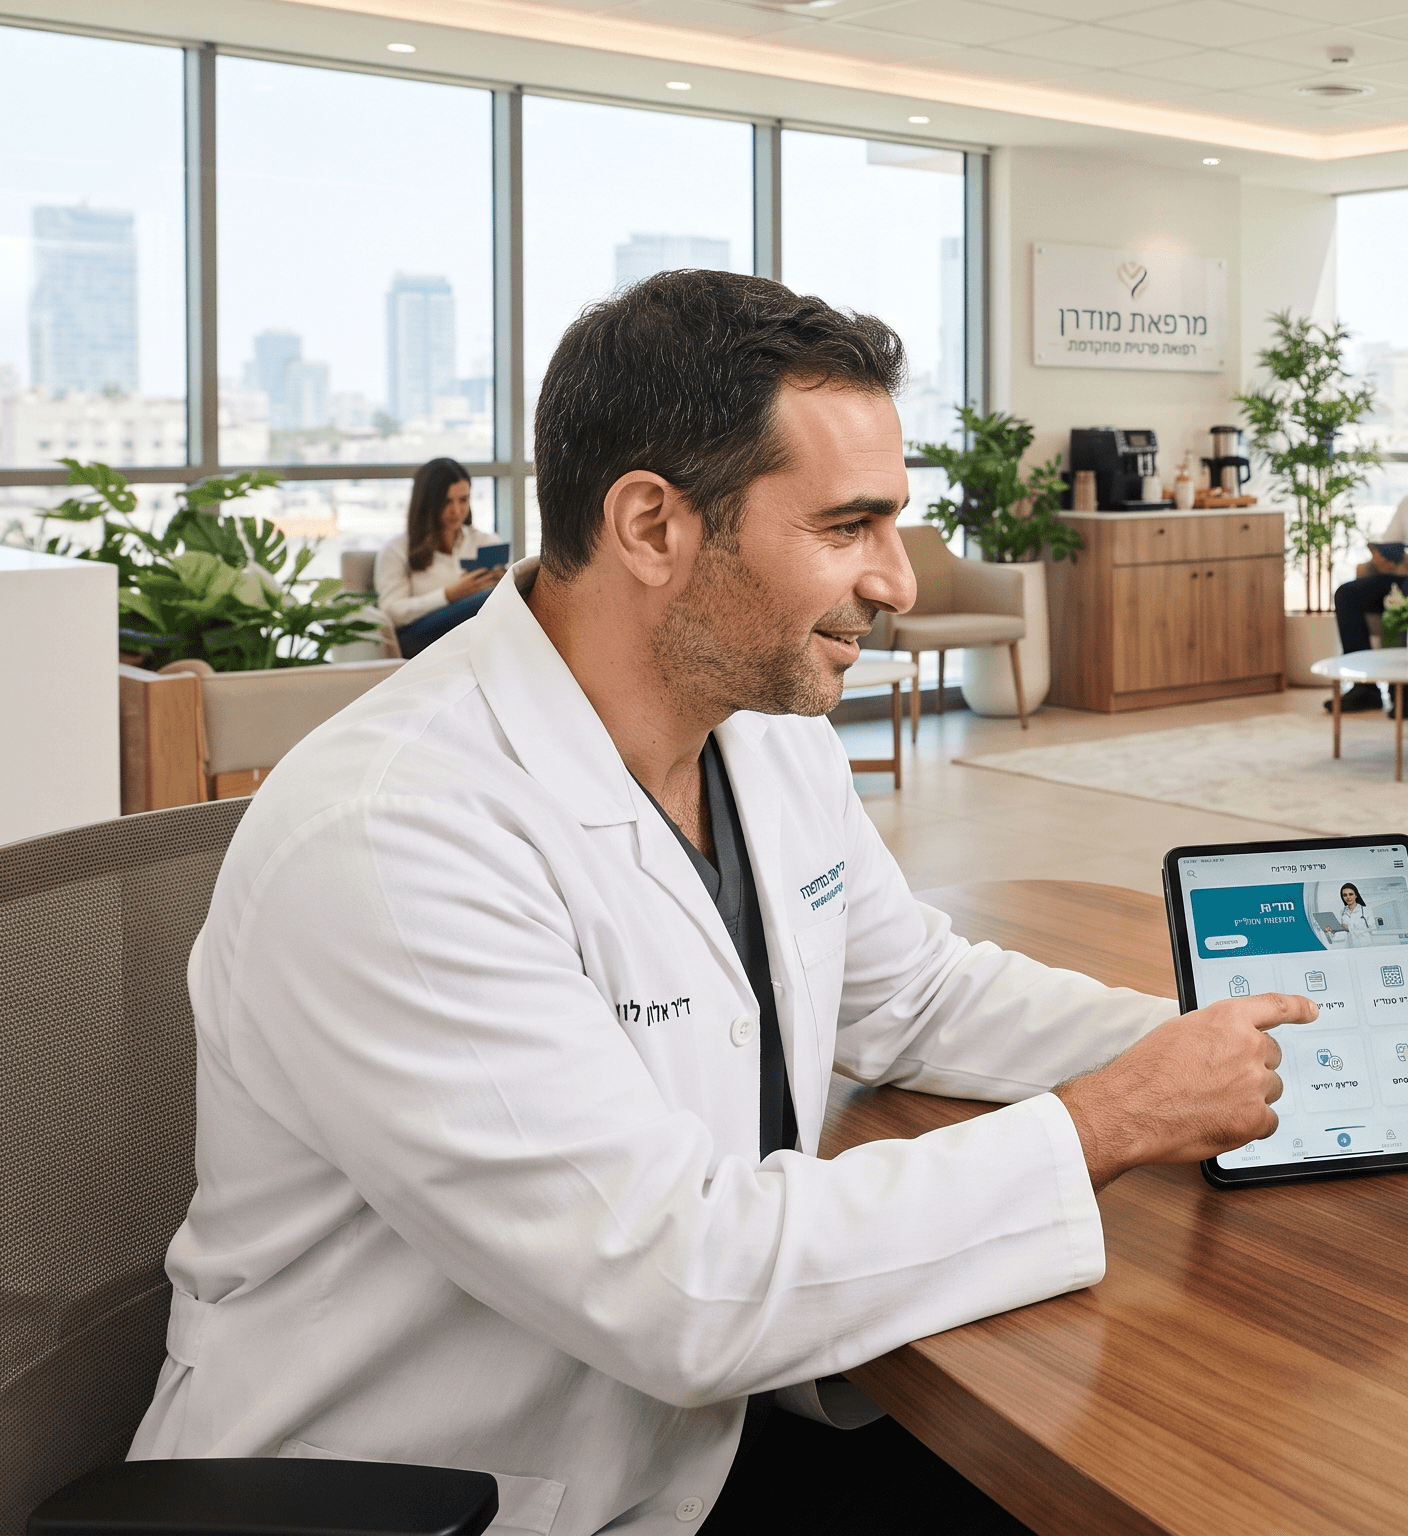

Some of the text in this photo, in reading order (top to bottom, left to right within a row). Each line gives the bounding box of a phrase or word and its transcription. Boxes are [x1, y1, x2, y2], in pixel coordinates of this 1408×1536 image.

[1058, 308, 1208, 337] מרפאת מודרן
[646, 1000, 669, 1027] אלון
